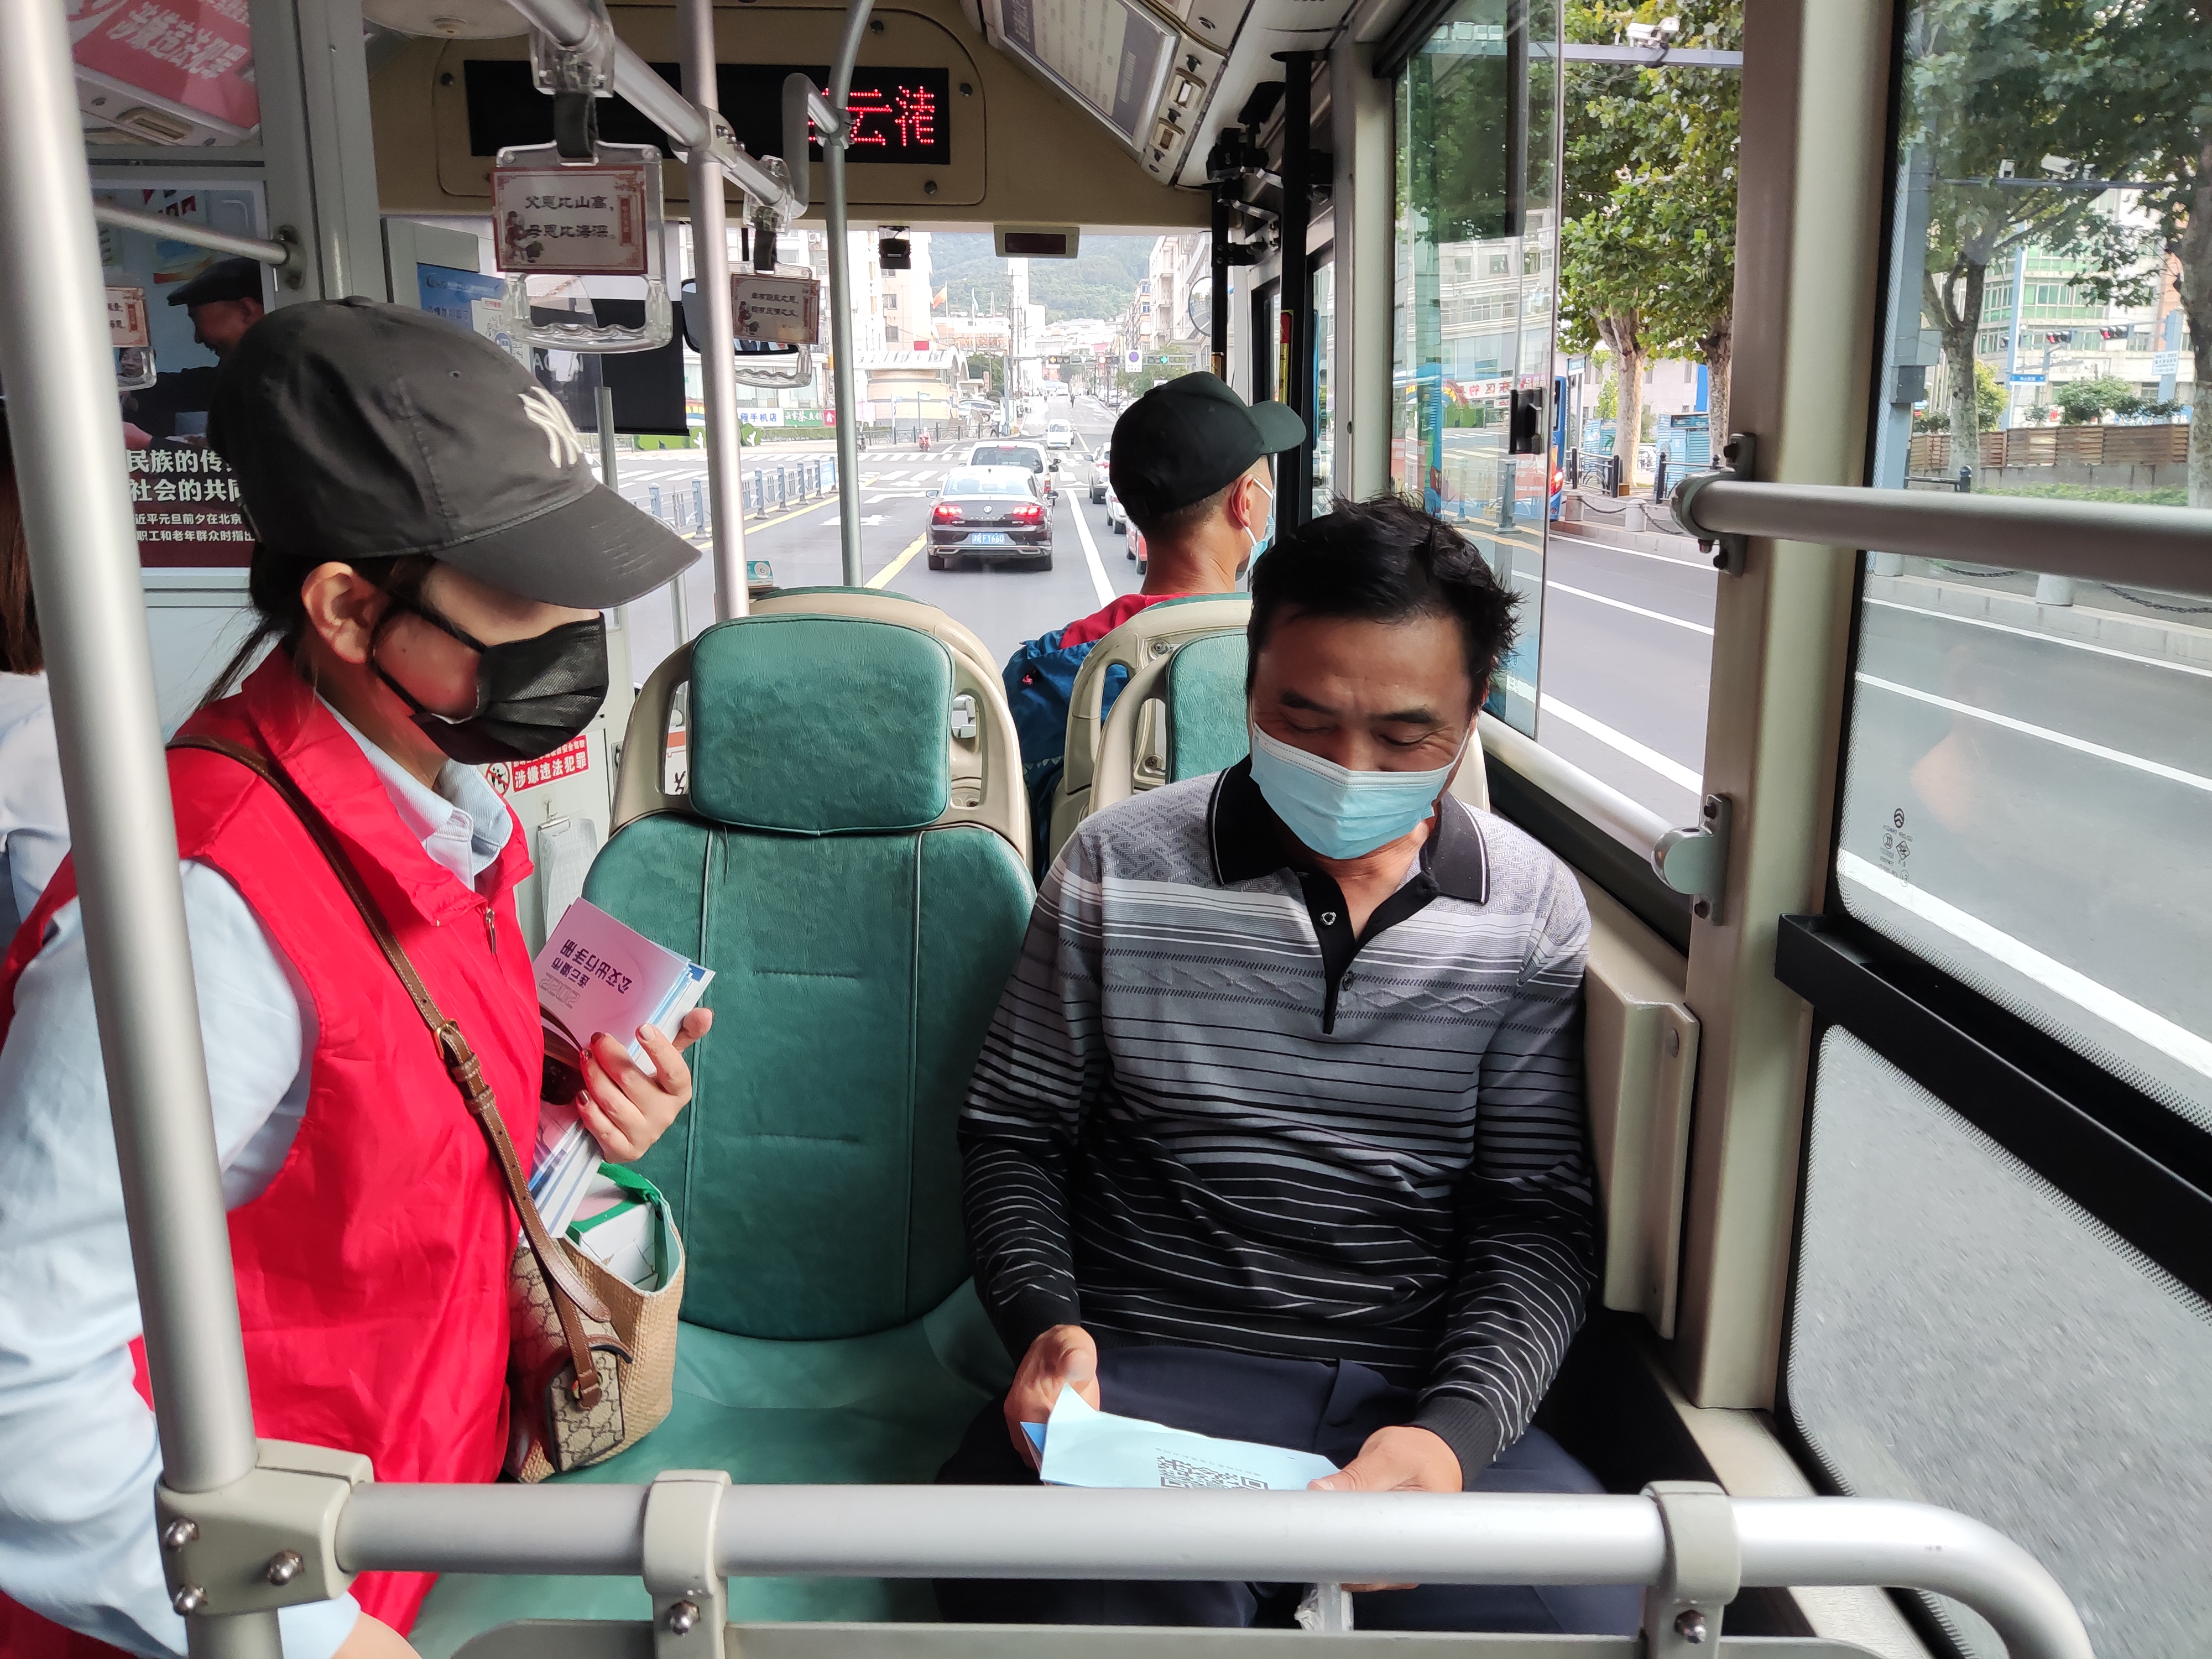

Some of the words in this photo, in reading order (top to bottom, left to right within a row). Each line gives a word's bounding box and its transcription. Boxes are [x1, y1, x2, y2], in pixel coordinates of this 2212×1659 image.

[126, 449, 233, 473] 民族的传
[134, 513, 242, 525] 近平元旦前夕在北京
[514, 752, 587, 789] 涉嫌违法犯罪
[551, 957, 590, 989] 连云港市
[560, 939, 633, 994] 公交出行手册
[539, 972, 581, 1009] 2022
